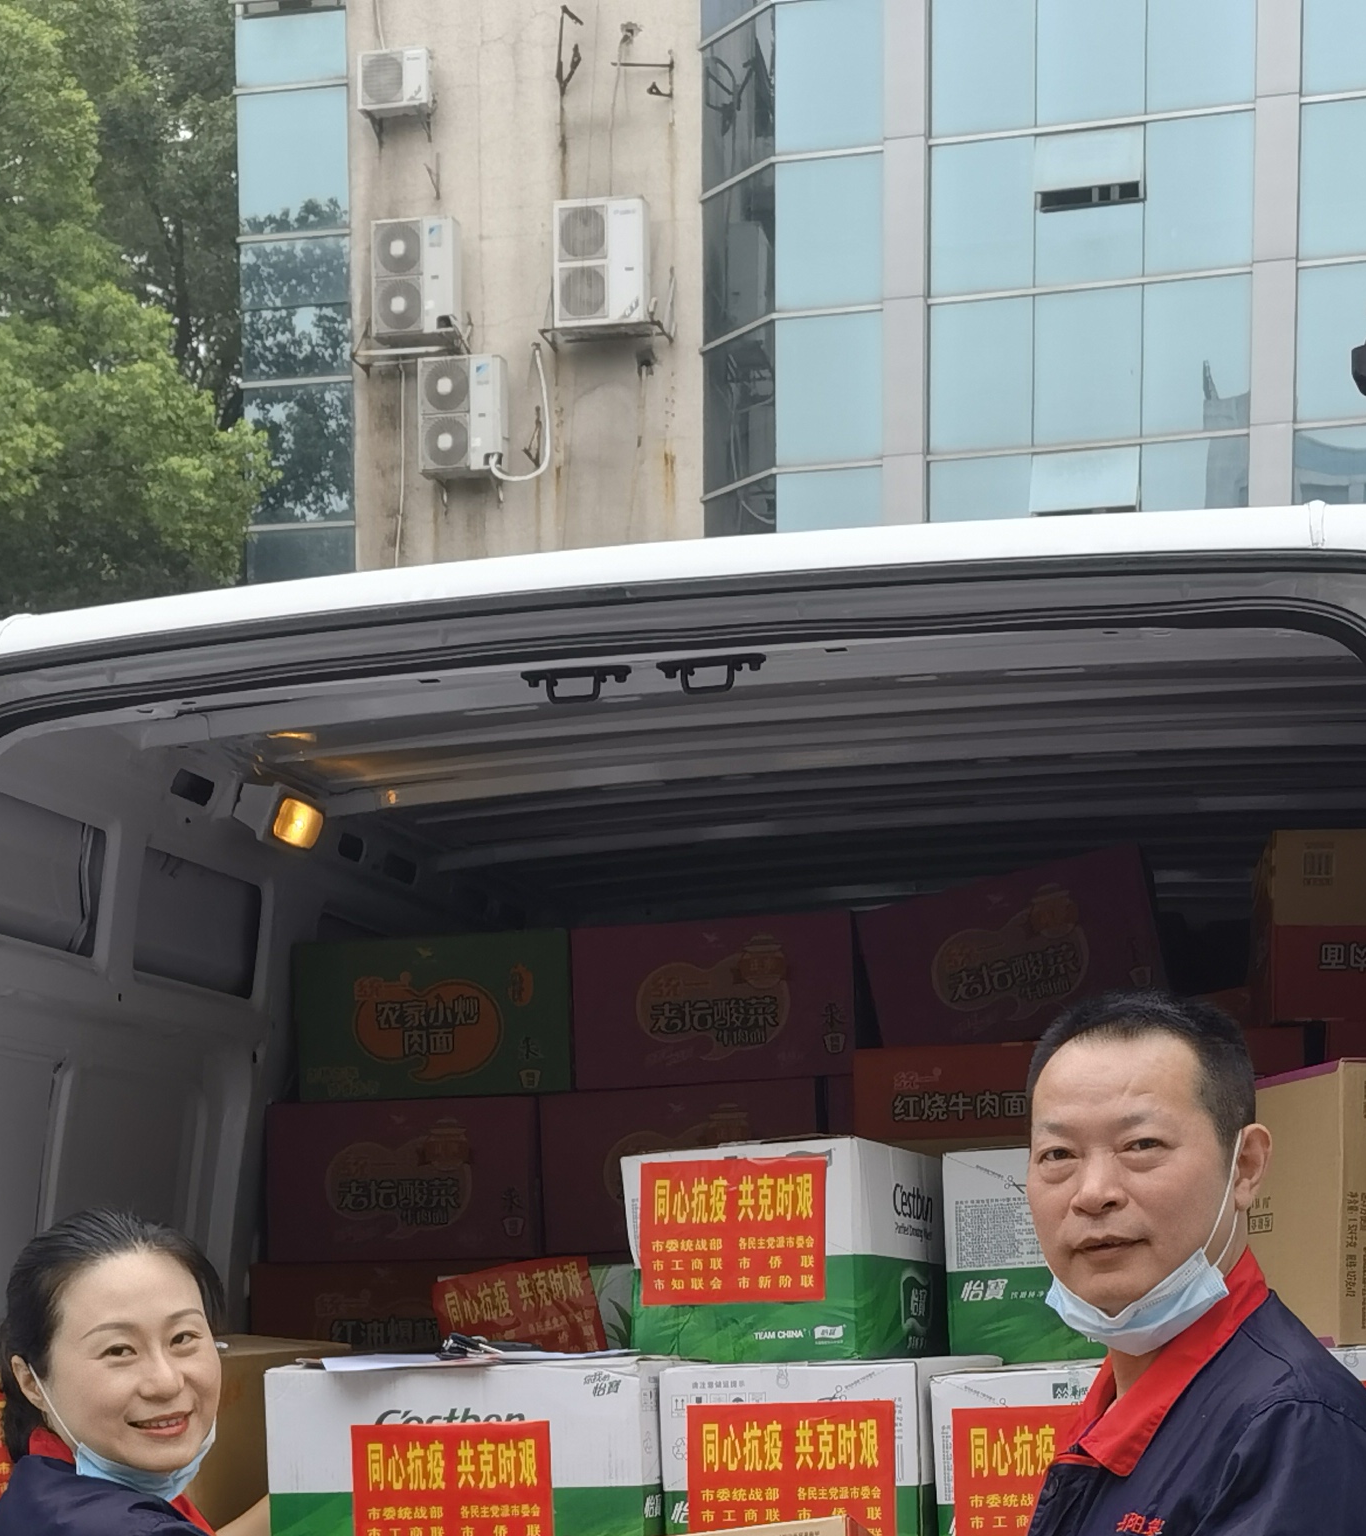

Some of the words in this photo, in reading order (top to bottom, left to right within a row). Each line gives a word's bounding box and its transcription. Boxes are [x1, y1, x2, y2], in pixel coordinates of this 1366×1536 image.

[376, 994, 480, 1029] 农家小炒
[650, 995, 779, 1033] 老坛酸菜
[403, 1028, 454, 1057] 肉面
[893, 1091, 1026, 1121] 红烧牛肉面
[337, 1177, 460, 1212] 老坛酸菜
[653, 1176, 727, 1224] 同心抗疫
[737, 1172, 813, 1221] 共克时艰
[651, 1238, 722, 1252] 市委统战部
[738, 1235, 814, 1250] 各民主党派市委会
[653, 1256, 722, 1271] 市工商联
[738, 1253, 814, 1269] 市侨联
[656, 1277, 722, 1290] 市知联会
[738, 1274, 814, 1289] 市新阶联
[960, 1278, 1008, 1302] 怡寶
[445, 1277, 514, 1330] 同心抗疫
[517, 1261, 584, 1310] 共克时艰
[753, 1331, 775, 1340] TEAM
[778, 1330, 803, 1339] CHINA
[701, 1420, 783, 1472] 同心抗疫
[795, 1419, 879, 1470] 共克时艰
[969, 1424, 1055, 1477] 同心抗疫
[367, 1440, 445, 1490] 同心抗疫
[457, 1438, 537, 1489] 共克时艰
[701, 1487, 779, 1502] 市委统战部
[797, 1485, 881, 1500] 各民主党派市委会
[969, 1493, 1034, 1508] 市委统战
[368, 1506, 443, 1520] 市委统战部
[461, 1504, 540, 1518] 各民主党派市委会
[701, 1508, 780, 1526] 市工商联
[970, 1514, 1028, 1529] 市工商
